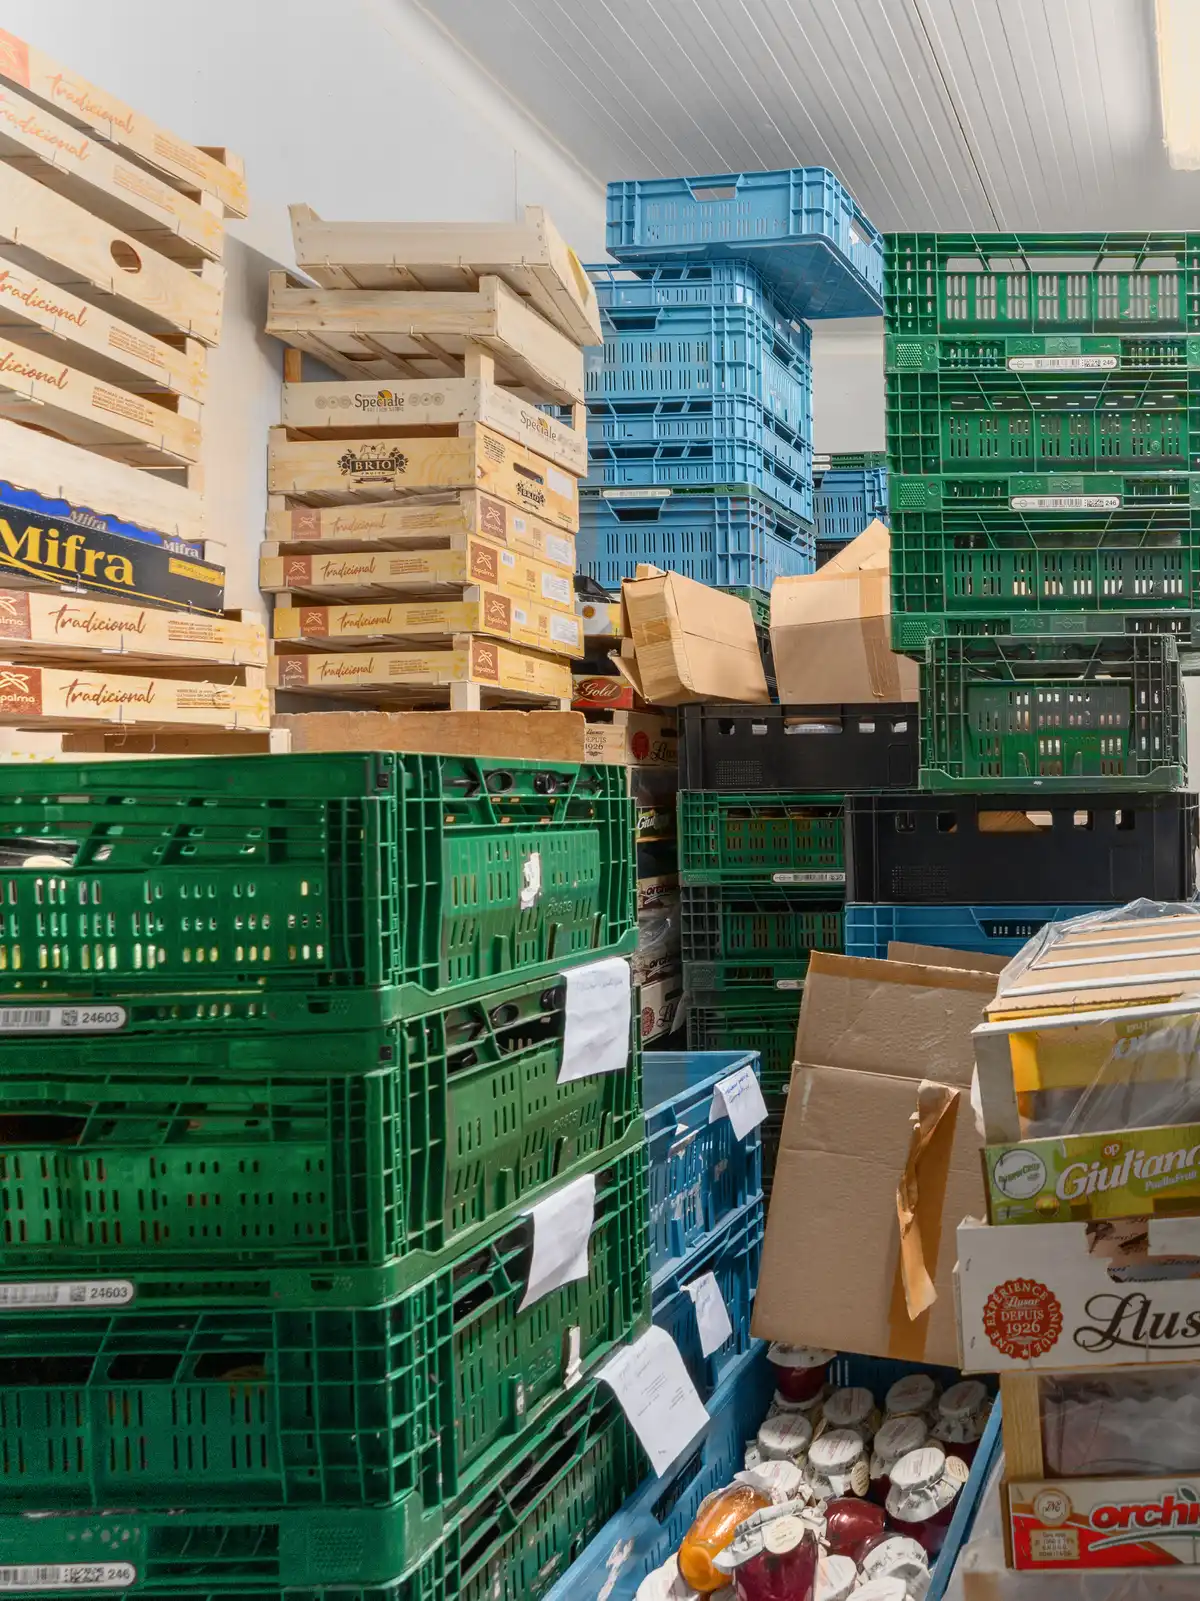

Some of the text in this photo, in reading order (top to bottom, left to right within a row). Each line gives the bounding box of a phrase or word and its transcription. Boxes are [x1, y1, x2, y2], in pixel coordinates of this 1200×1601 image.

[0, 94, 90, 161] radicional
[354, 393, 404, 412] Speciale
[520, 410, 557, 441] Speciale
[355, 459, 393, 471] BRIO
[69, 510, 107, 530] Mifra
[0, 518, 136, 587] Mifra
[163, 538, 200, 558] Mifra
[581, 677, 617, 697] Gold
[82, 1012, 120, 1024] 24603
[91, 1287, 128, 1299] 24603
[1002, 1310, 1044, 1321] DEPUIS
[1006, 1320, 1040, 1335] 1926
[1034, 1302, 1060, 1353] UNIQUE
[108, 1568, 130, 1580] 246
